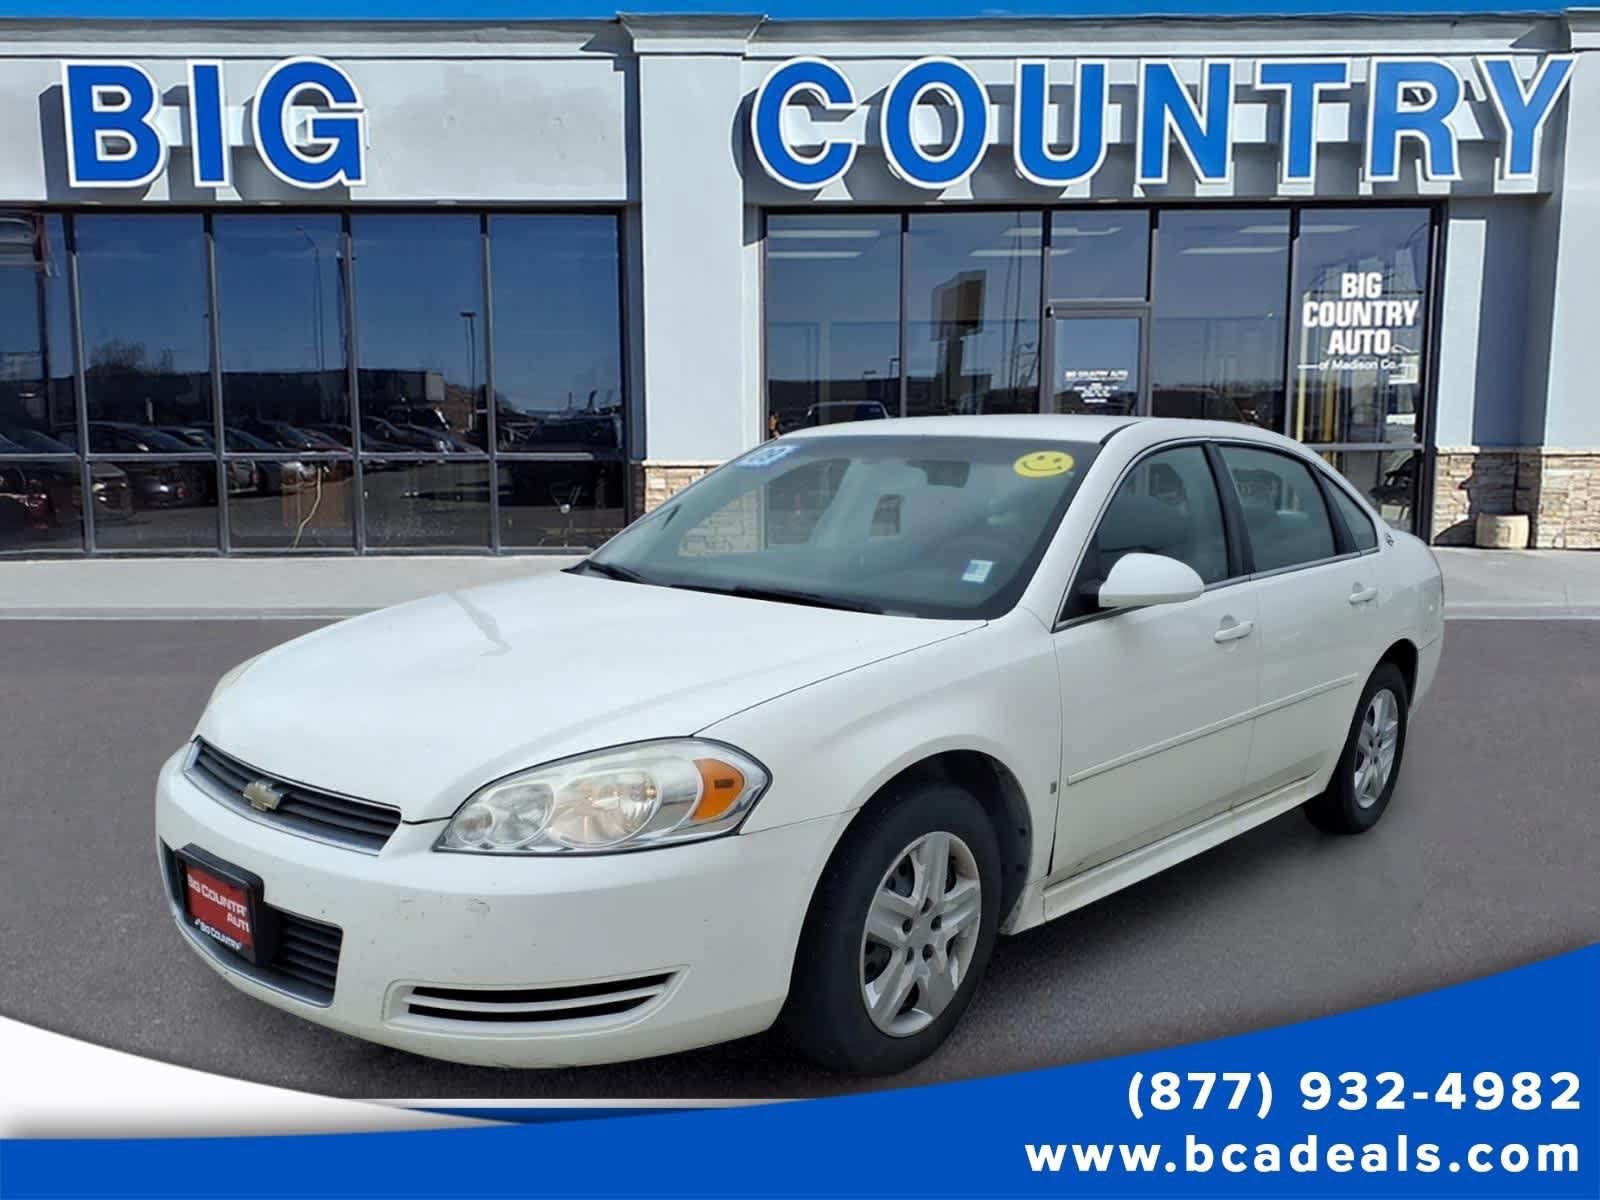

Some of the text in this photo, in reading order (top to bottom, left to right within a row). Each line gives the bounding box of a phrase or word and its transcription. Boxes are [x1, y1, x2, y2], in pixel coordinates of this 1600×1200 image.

[62, 55, 1577, 190] BIG COUNTRY
[1341, 271, 1382, 299] BIG
[1302, 300, 1420, 328] COUNTRY
[1327, 328, 1391, 356] AUTO
[1319, 359, 1329, 370] of
[1331, 359, 1378, 370] Madison
[201, 884, 248, 917] COUNTR
[227, 912, 250, 933] AUT
